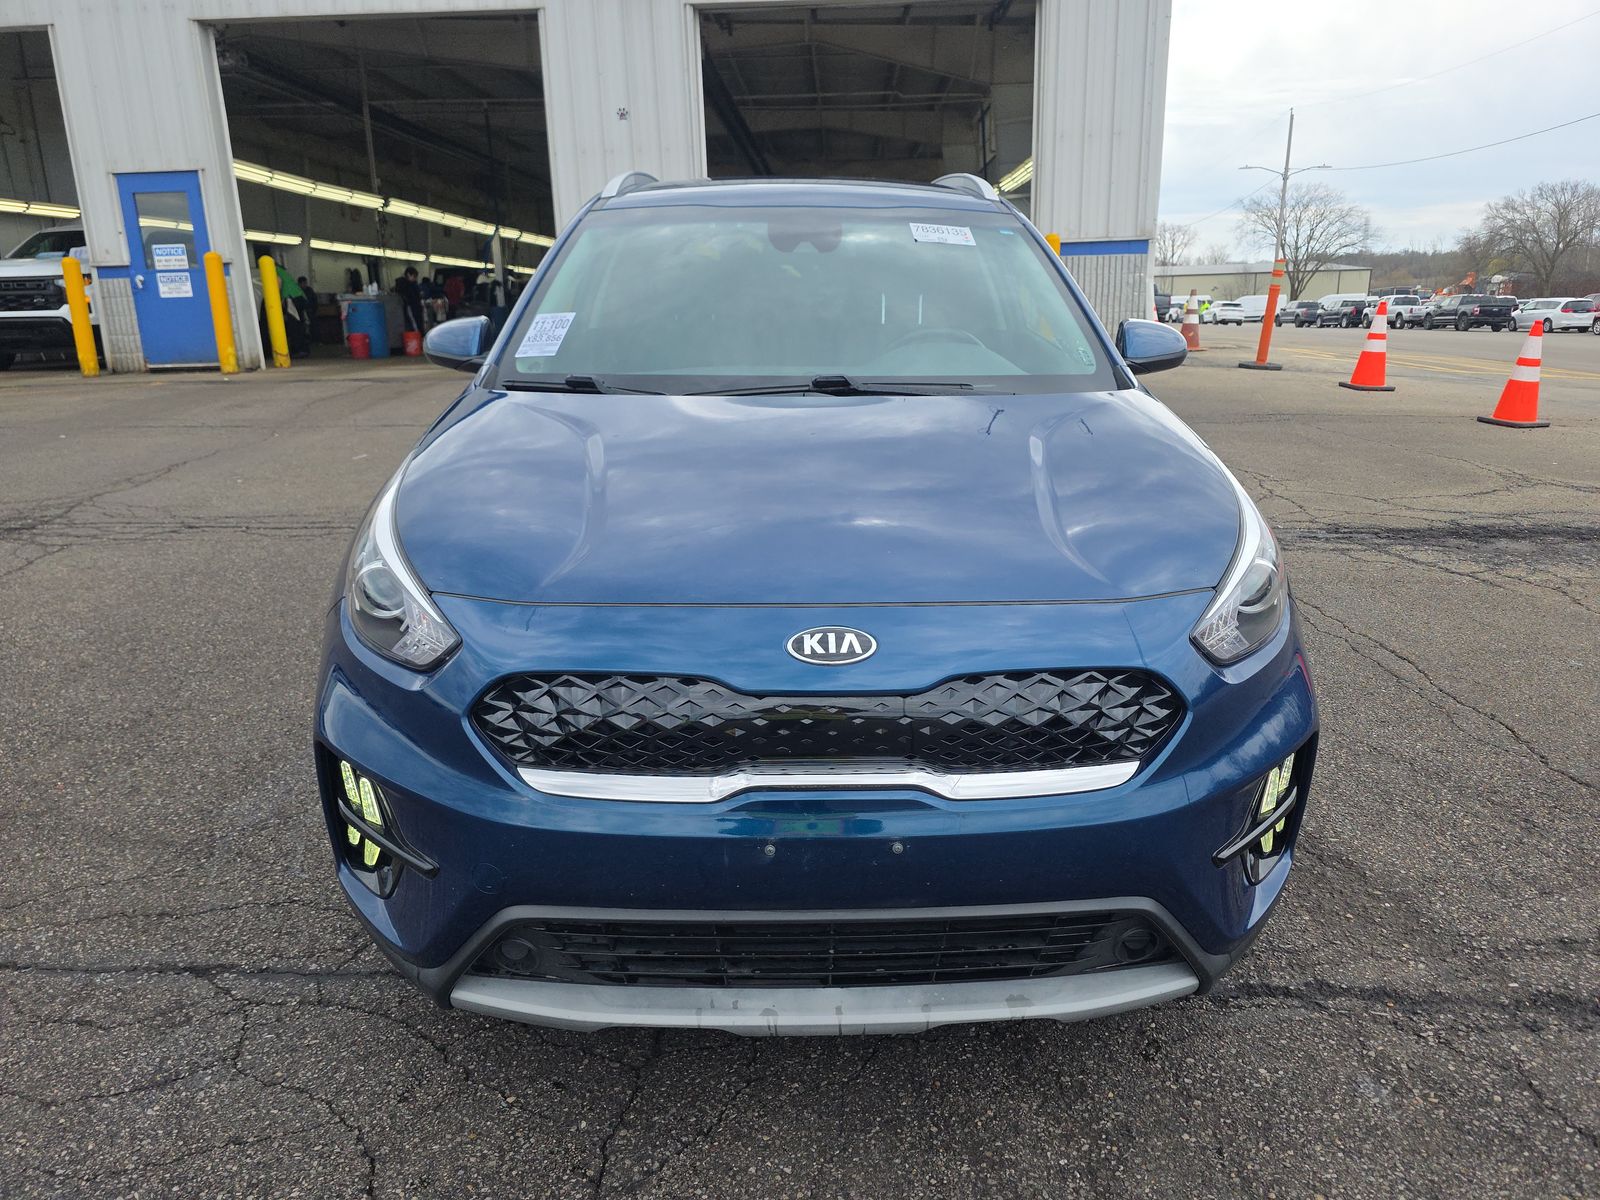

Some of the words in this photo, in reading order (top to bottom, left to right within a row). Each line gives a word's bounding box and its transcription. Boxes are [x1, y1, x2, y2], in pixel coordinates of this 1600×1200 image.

[155, 248, 184, 256] NOTICE
[160, 275, 188, 283] NOTICE
[802, 632, 863, 655] KIA
